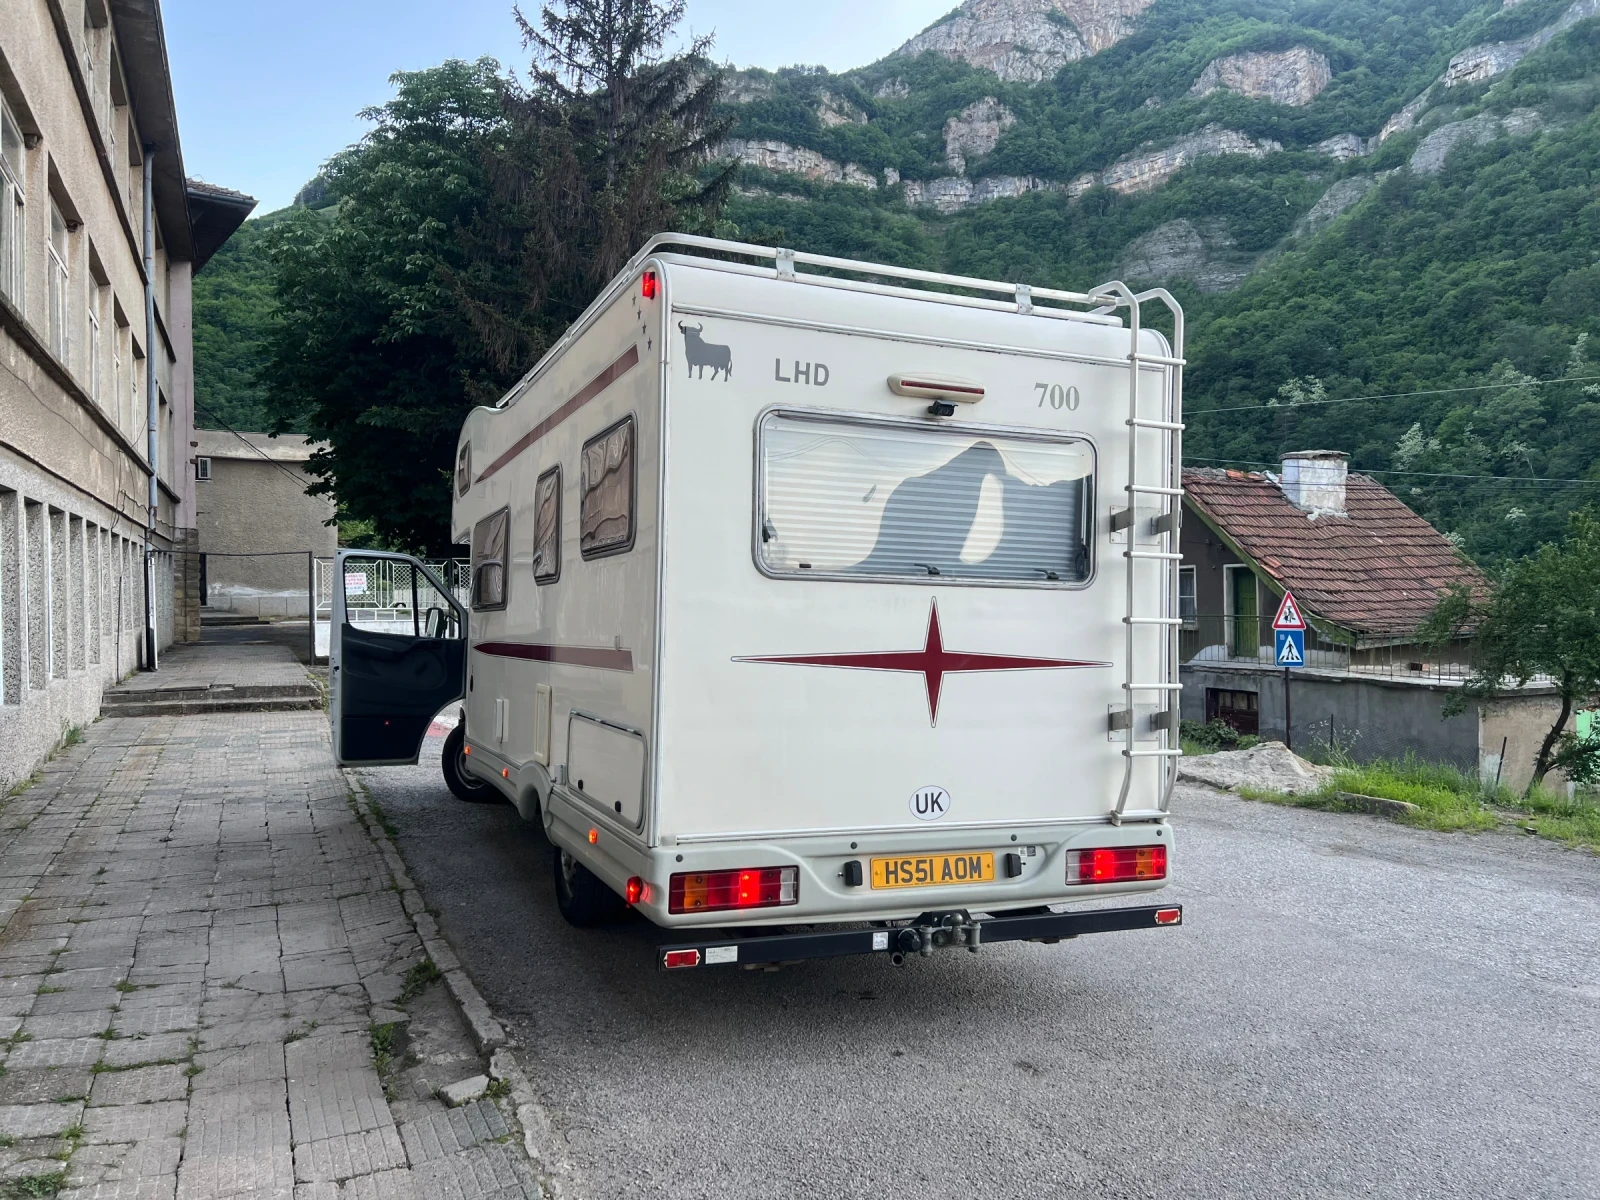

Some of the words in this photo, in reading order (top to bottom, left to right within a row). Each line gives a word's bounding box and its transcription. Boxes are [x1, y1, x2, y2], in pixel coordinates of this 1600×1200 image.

[775, 357, 830, 387] LHD
[1033, 382, 1080, 411] 700
[915, 791, 944, 814] UK
[885, 858, 934, 885] HS51
[941, 856, 982, 881] AOM
